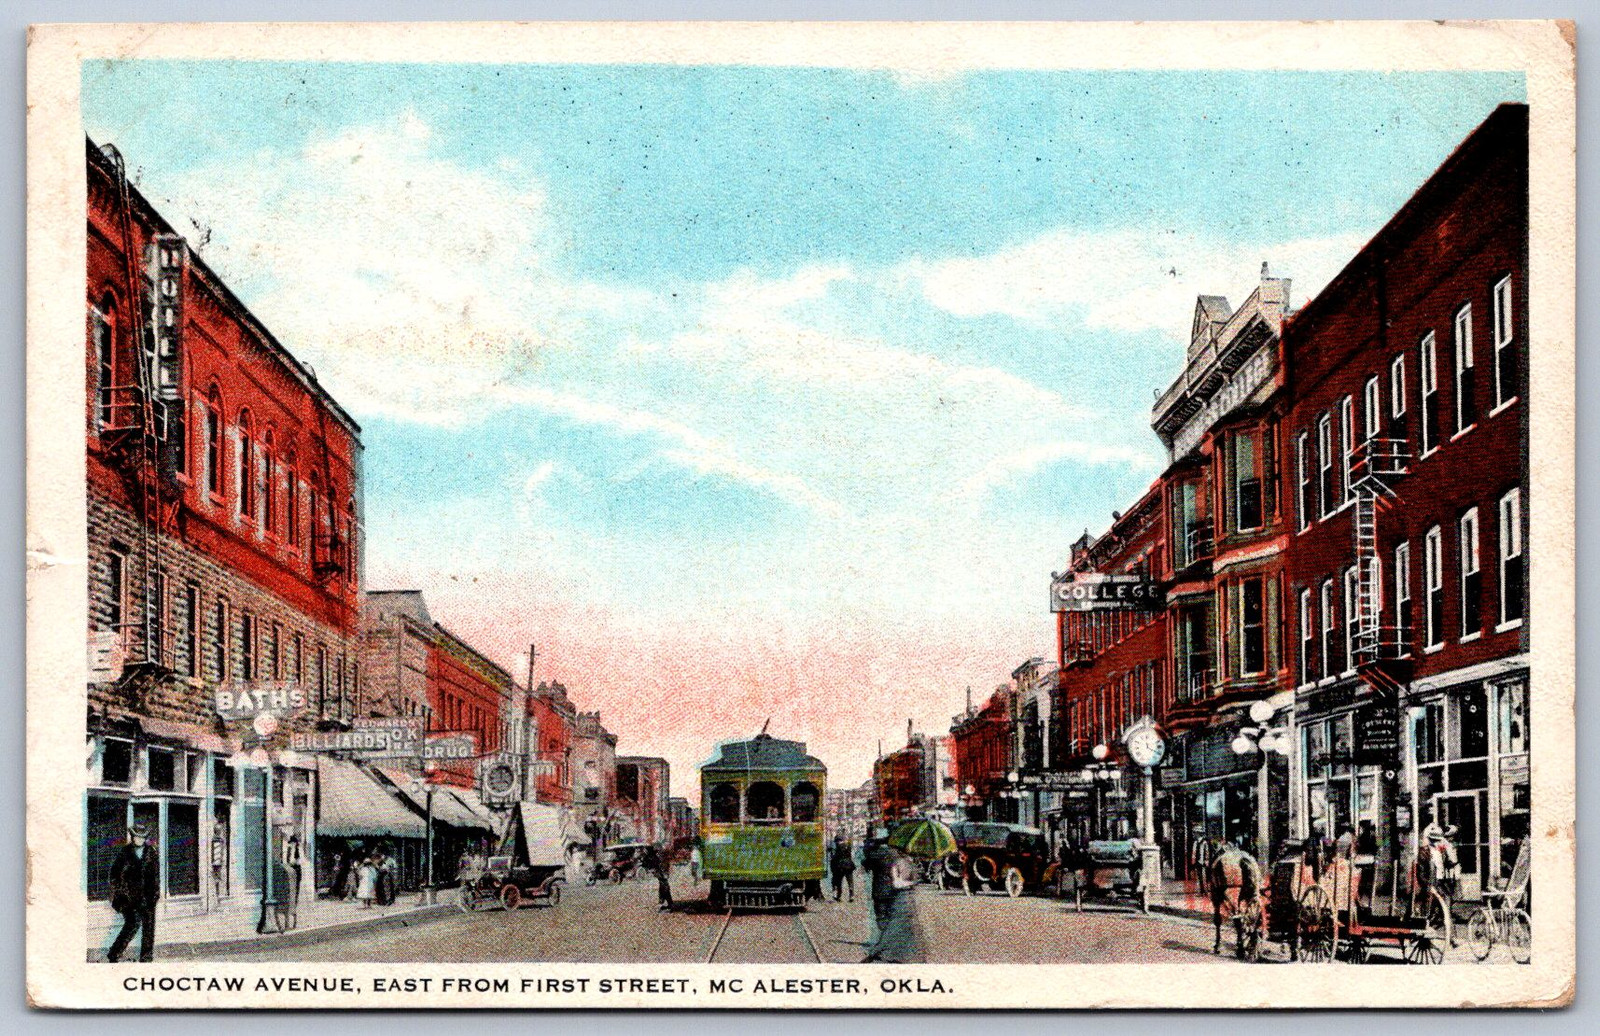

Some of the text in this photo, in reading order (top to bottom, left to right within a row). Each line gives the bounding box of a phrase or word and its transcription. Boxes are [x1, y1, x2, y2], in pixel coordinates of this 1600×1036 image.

[1059, 584, 1158, 600] COLLEGE
[215, 688, 307, 711] BATHS
[295, 732, 386, 749] BILLIARDS
